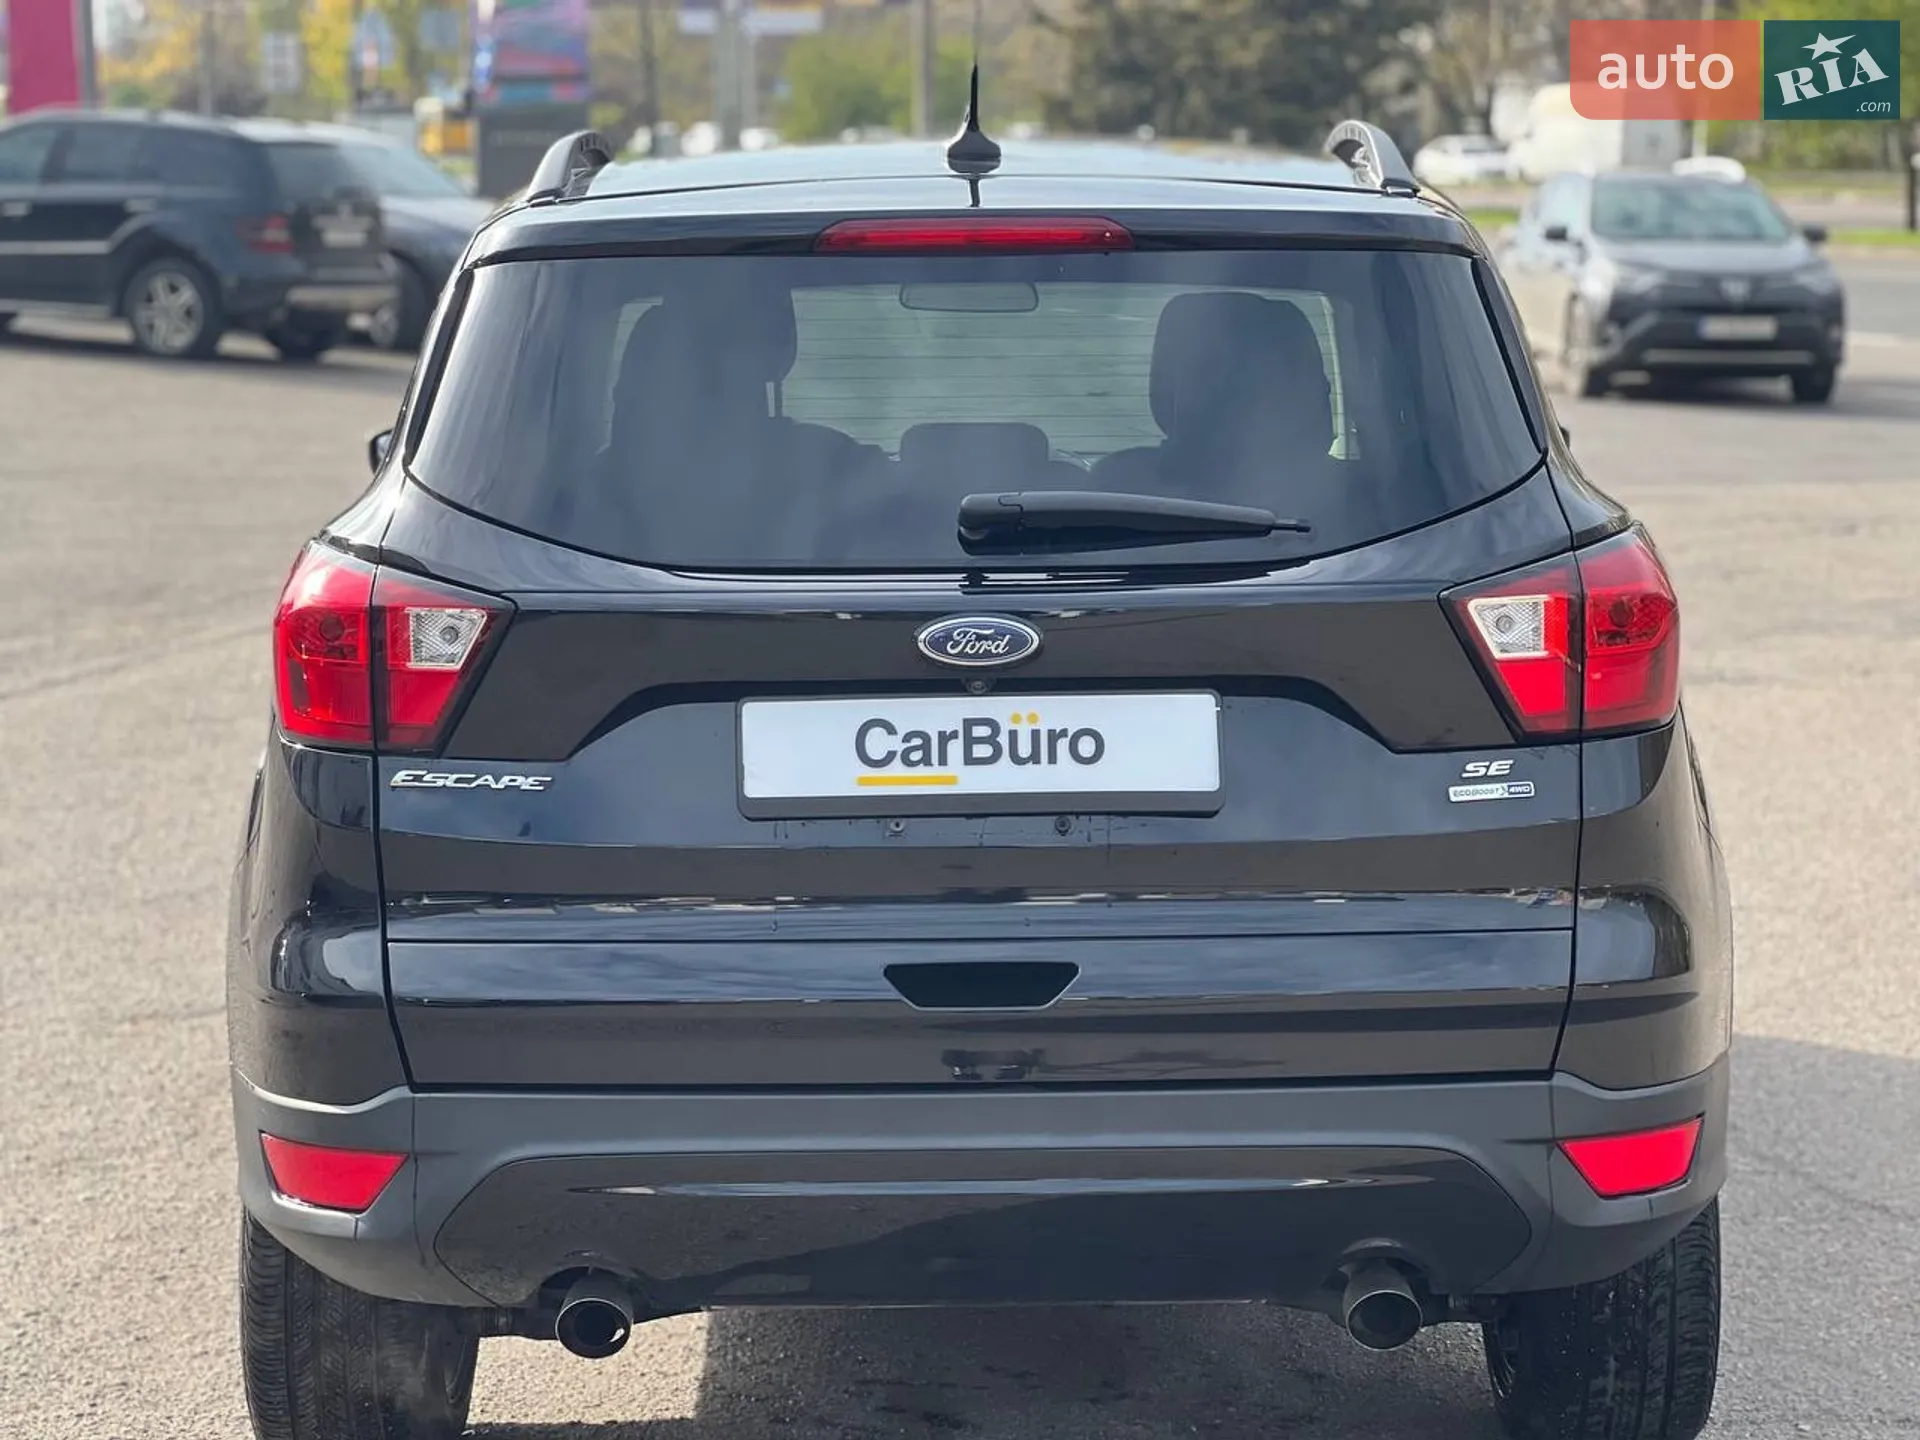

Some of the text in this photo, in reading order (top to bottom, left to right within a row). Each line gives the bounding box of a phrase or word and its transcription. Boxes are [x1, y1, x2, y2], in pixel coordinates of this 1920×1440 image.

[946, 627, 1012, 654] Ford
[855, 712, 1105, 768] CarBüro
[390, 769, 552, 791] ESCAPE
[1461, 759, 1514, 778] SE
